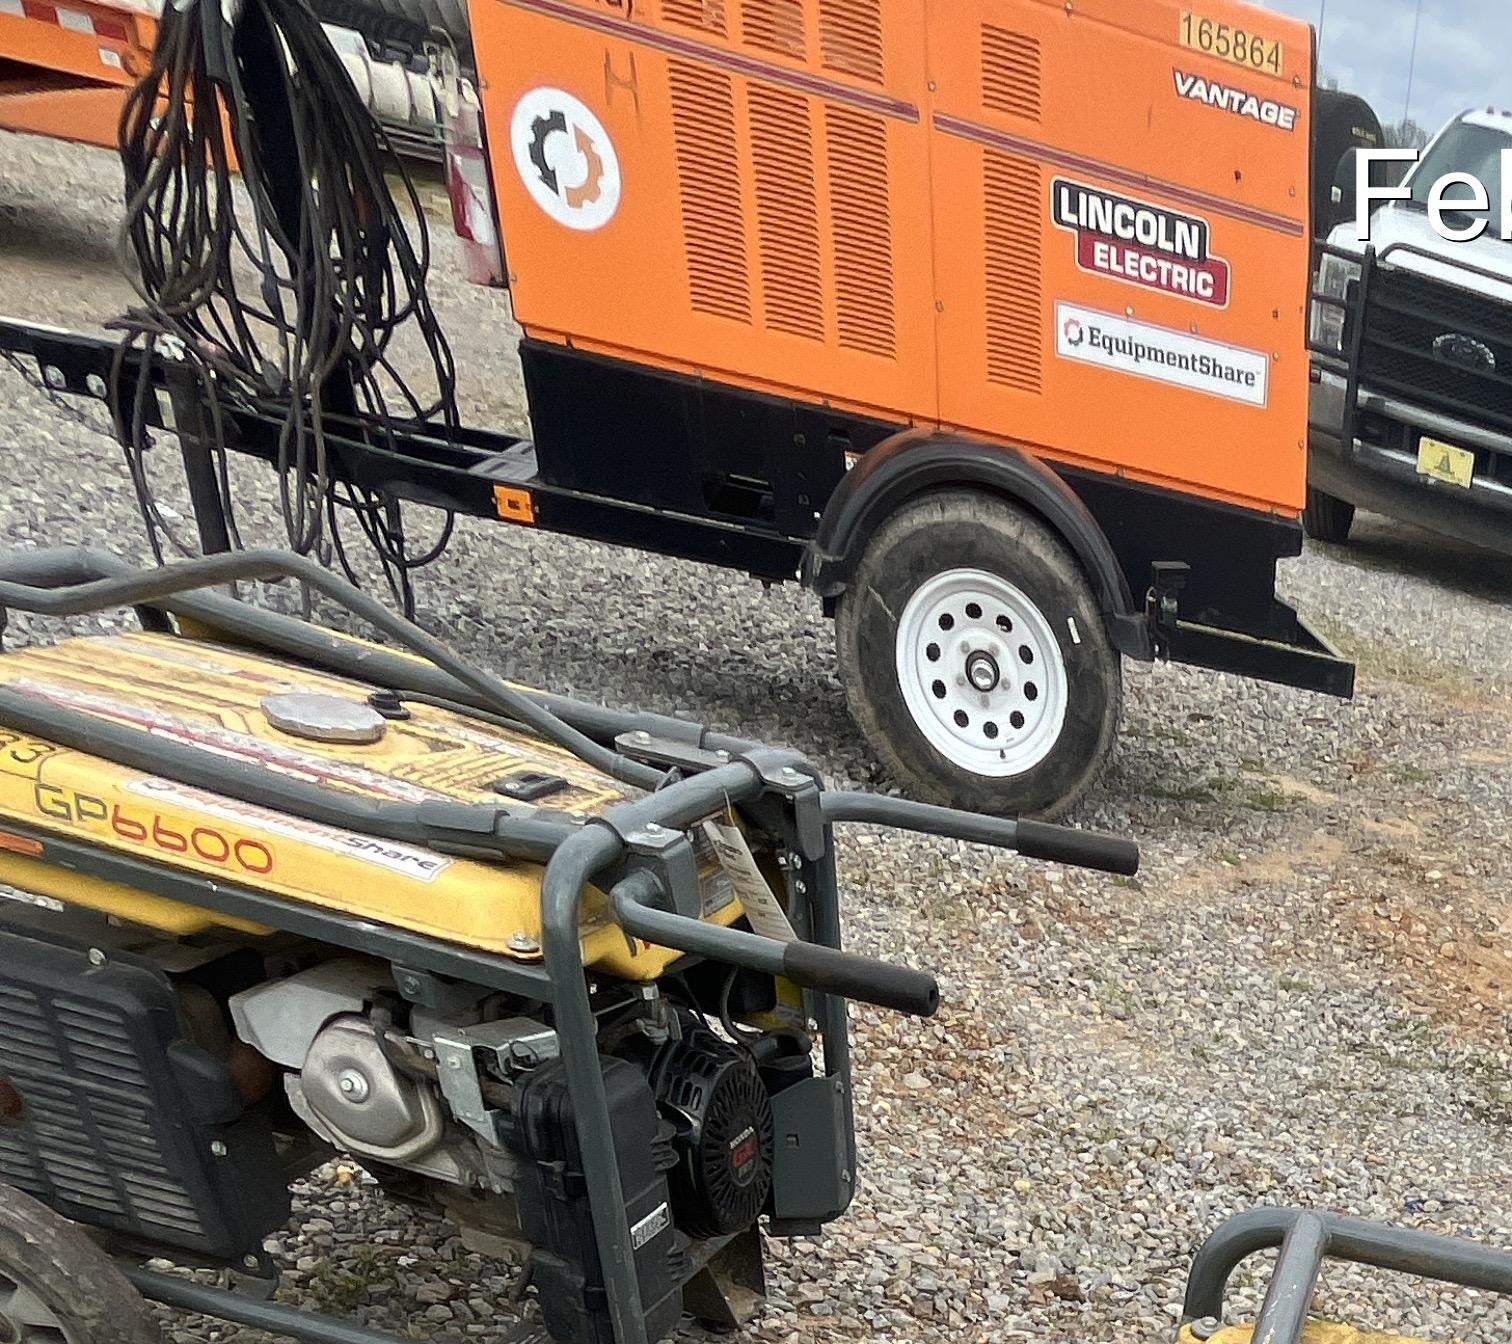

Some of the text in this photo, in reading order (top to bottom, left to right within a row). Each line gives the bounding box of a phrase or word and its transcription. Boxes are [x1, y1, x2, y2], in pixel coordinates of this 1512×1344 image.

[1182, 13, 1281, 74] 165864
[1173, 68, 1296, 131] VANTAGE
[1058, 186, 1200, 260] LINCOLN
[1093, 241, 1214, 298] ELECTRIC
[1088, 327, 1256, 388] EquipmentShare
[33, 782, 274, 874] GP6600
